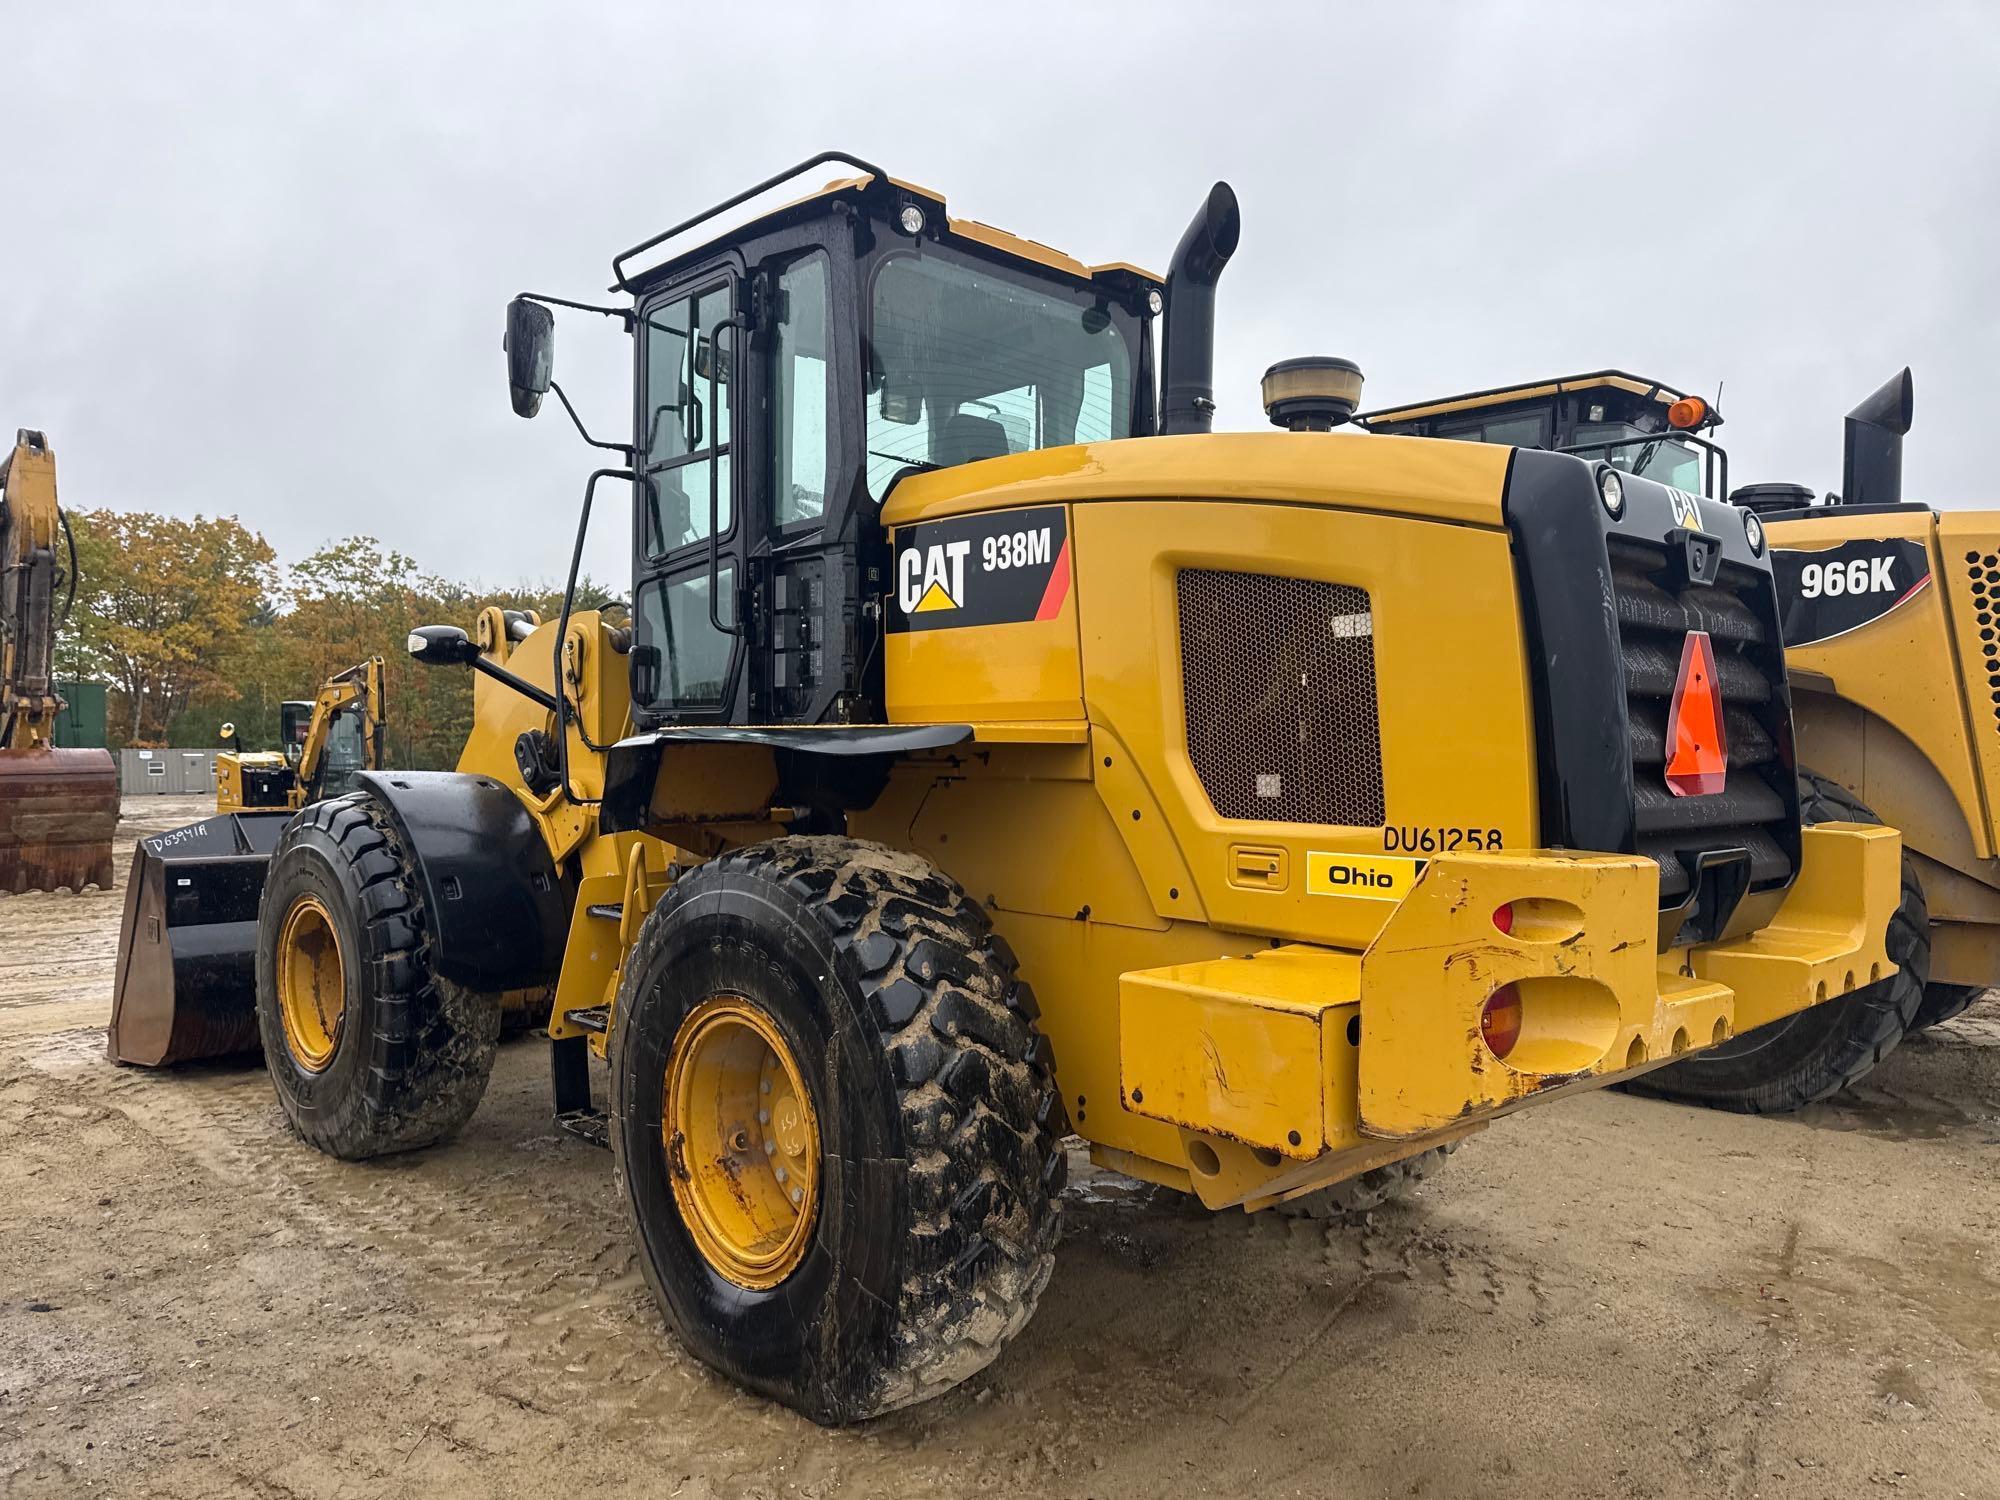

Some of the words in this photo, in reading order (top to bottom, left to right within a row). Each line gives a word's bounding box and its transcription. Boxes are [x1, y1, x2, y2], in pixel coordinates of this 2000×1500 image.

[1664, 486, 1704, 532] CAT
[899, 540, 970, 613] CAT
[982, 527, 1050, 571] 938M
[1801, 556, 1896, 598] 966K
[1384, 826, 1503, 852] DU61258
[1329, 866, 1393, 888] Ohio
